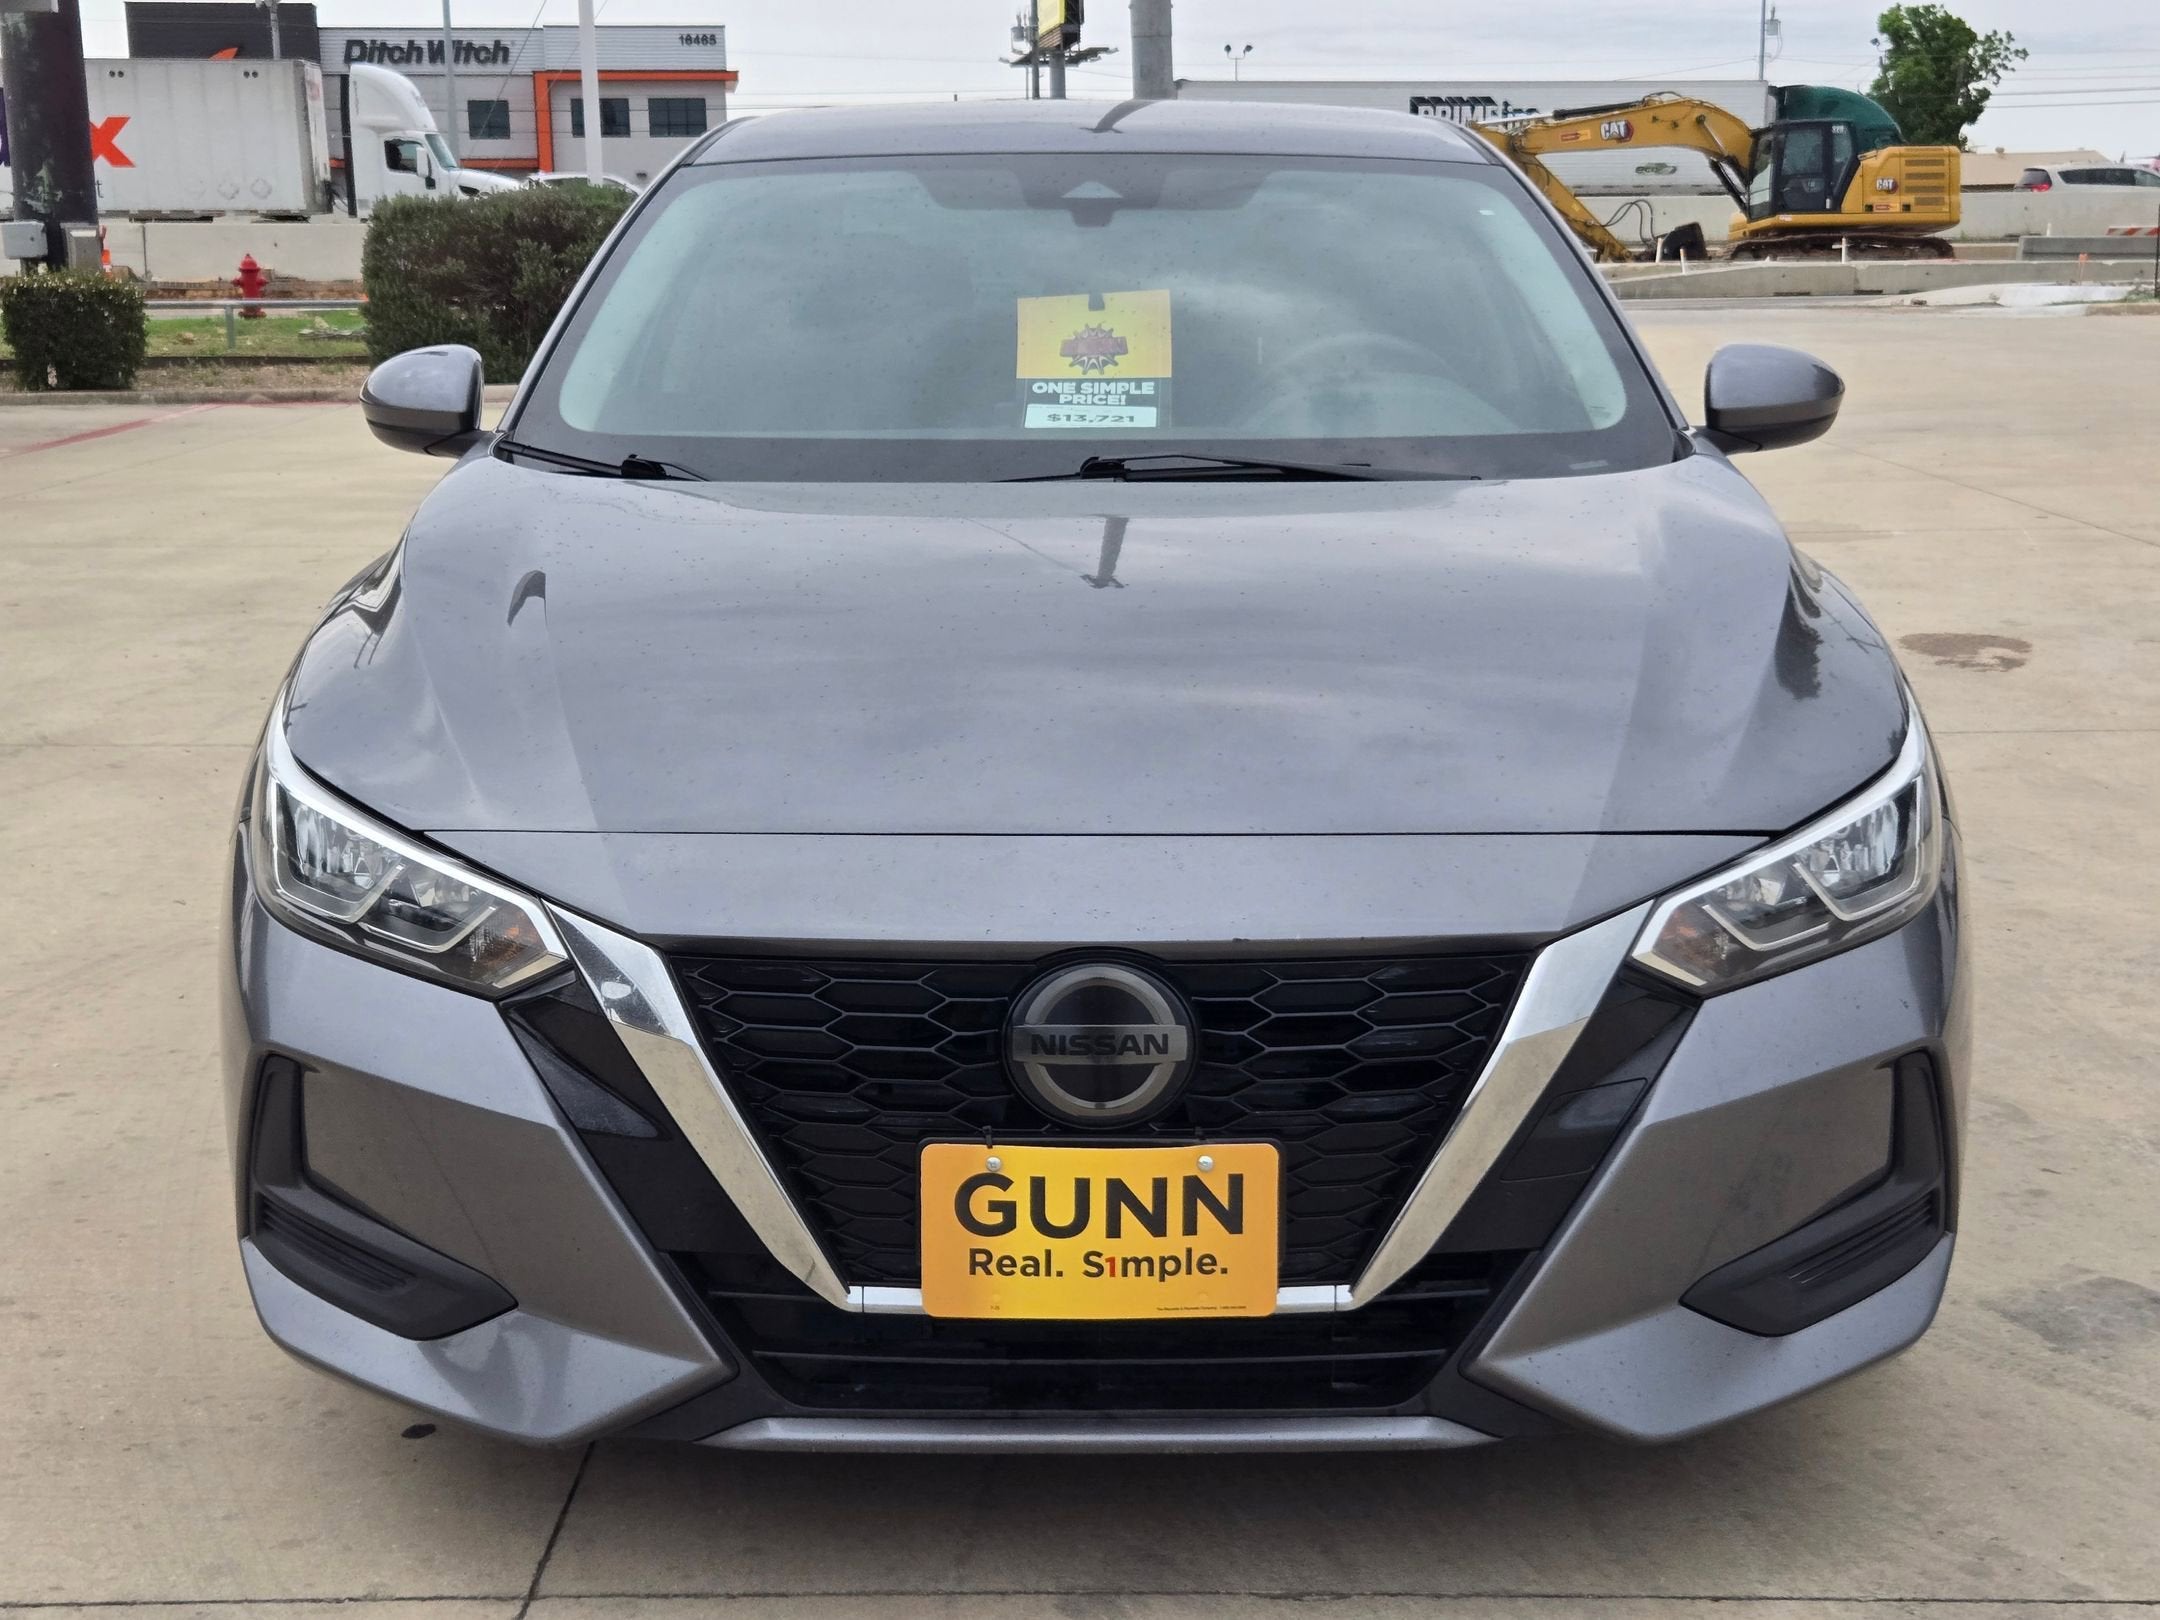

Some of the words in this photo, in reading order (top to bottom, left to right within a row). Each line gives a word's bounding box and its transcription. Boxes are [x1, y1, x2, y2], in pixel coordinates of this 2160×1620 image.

[344, 39, 424, 65] Ditch
[427, 39, 510, 65] Witch
[1600, 120, 1630, 140] CAT
[1876, 178, 1894, 191] CAT
[1032, 382, 1076, 394] ONE
[1080, 382, 1155, 394] SIMPLE
[1059, 394, 1126, 405] PRICE!
[1047, 413, 1135, 423] $13,721
[1031, 1033, 1169, 1056] NISSAN
[954, 1172, 1244, 1239] GUNN
[969, 1248, 1063, 1278] Real.
